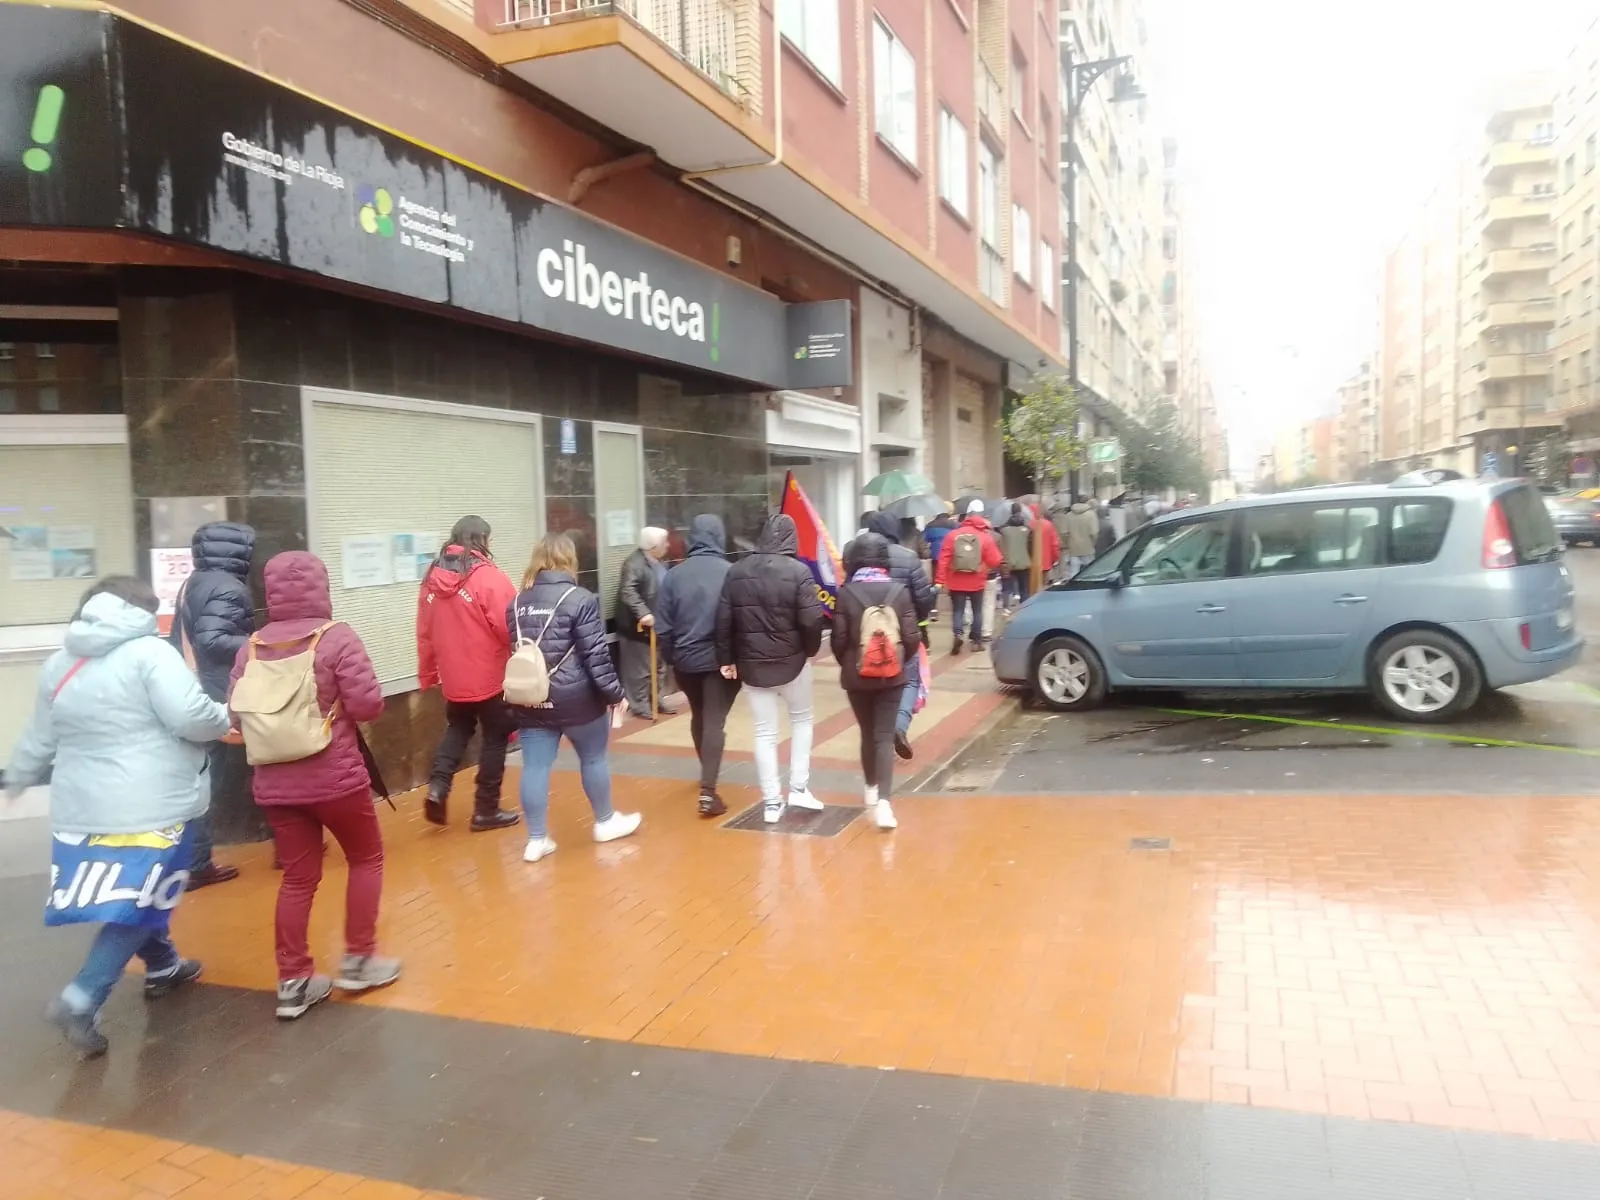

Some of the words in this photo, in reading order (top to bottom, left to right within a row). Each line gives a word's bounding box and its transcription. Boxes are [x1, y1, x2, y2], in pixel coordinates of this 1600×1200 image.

[222, 132, 283, 167] Gobierno
[284, 156, 300, 173] de
[315, 165, 345, 190] Rioja
[399, 196, 440, 220] Agencia
[441, 211, 456, 227] del
